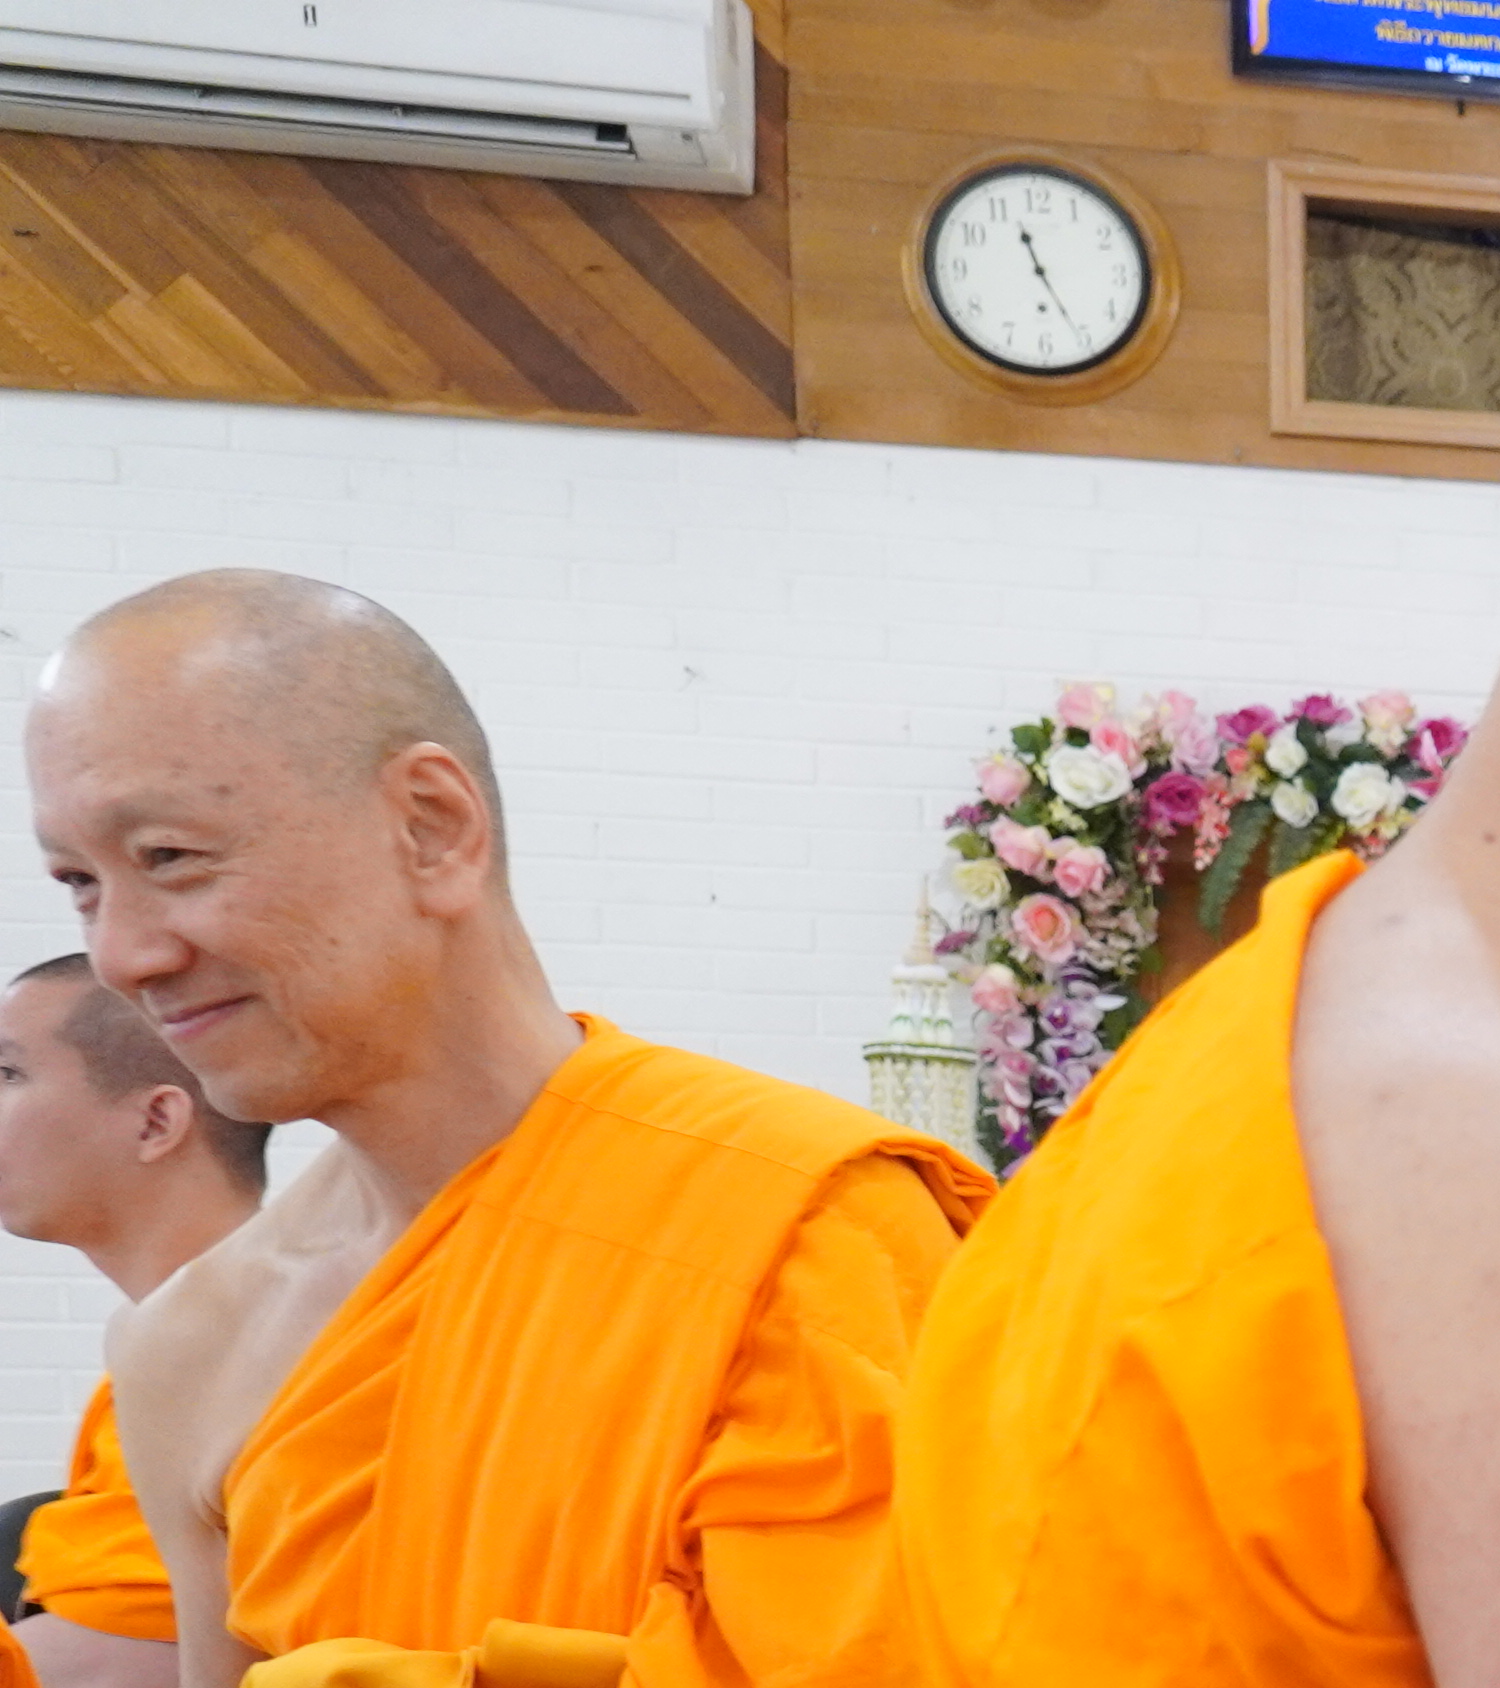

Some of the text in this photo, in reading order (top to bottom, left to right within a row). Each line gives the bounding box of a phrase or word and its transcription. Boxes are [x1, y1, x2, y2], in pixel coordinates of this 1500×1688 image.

[988, 197, 1008, 223] 11
[1024, 188, 1052, 214] 12
[962, 221, 986, 247] 10
[1097, 225, 1112, 251] 2
[953, 257, 967, 282] 9
[1112, 262, 1127, 287] 3
[968, 295, 982, 318] 8
[1002, 321, 1015, 347] 7
[1037, 332, 1053, 356] 6
